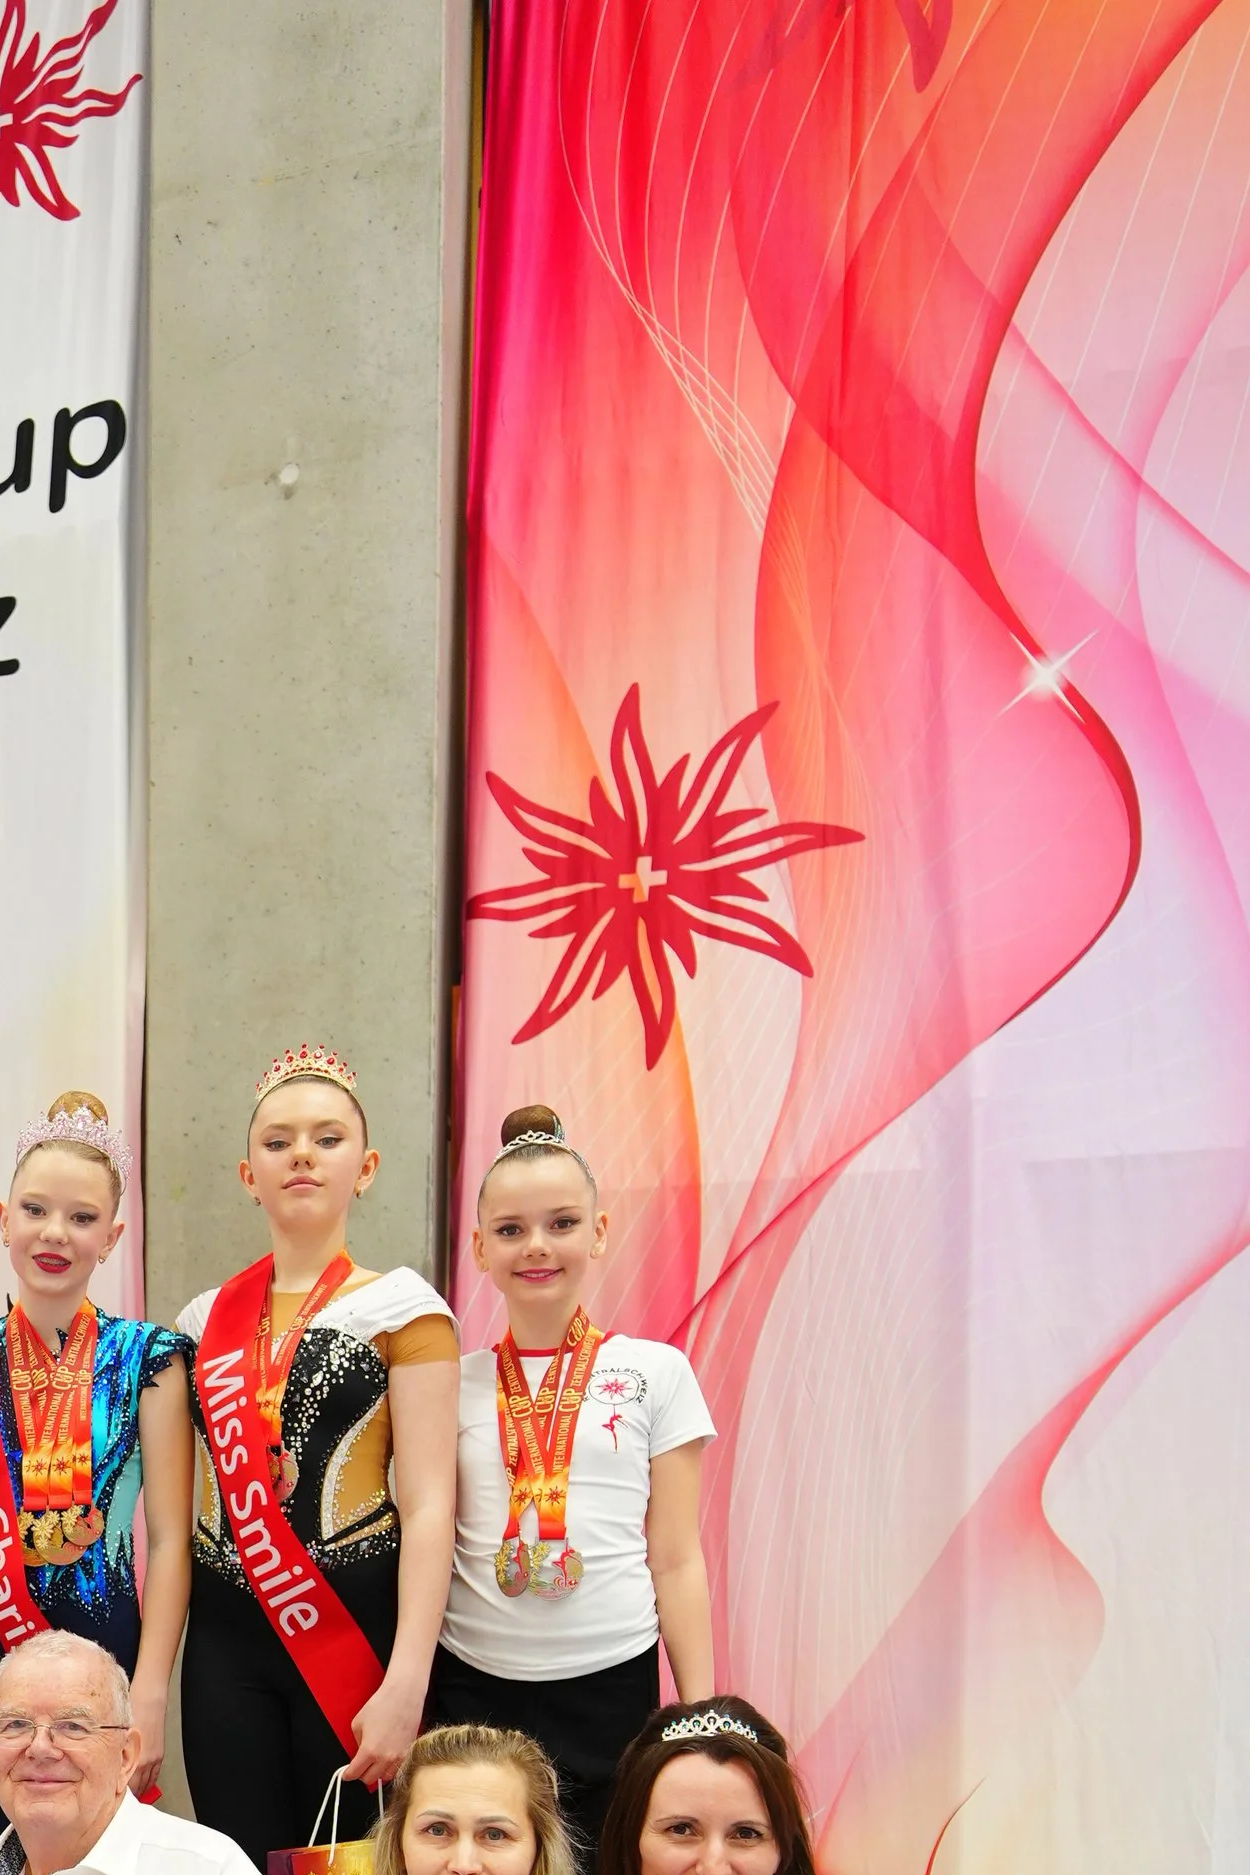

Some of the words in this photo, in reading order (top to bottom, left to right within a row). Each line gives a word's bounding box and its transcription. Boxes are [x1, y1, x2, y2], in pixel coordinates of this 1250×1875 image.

[566, 1317, 586, 1347] CUP
[11, 1368, 32, 1391] CUP
[51, 1365, 77, 1391] CUP
[78, 1369, 93, 1385] CUP
[509, 1395, 534, 1418] CUP
[534, 1386, 557, 1413] CUP
[558, 1387, 584, 1412] CUP
[18, 1391, 37, 1447] INTERNATIONAL
[520, 1417, 546, 1474] INTERNATIONAL
[552, 1413, 573, 1473] INTERNATIONAL
[202, 1348, 249, 1476] Miss
[230, 1480, 320, 1638] Smile
